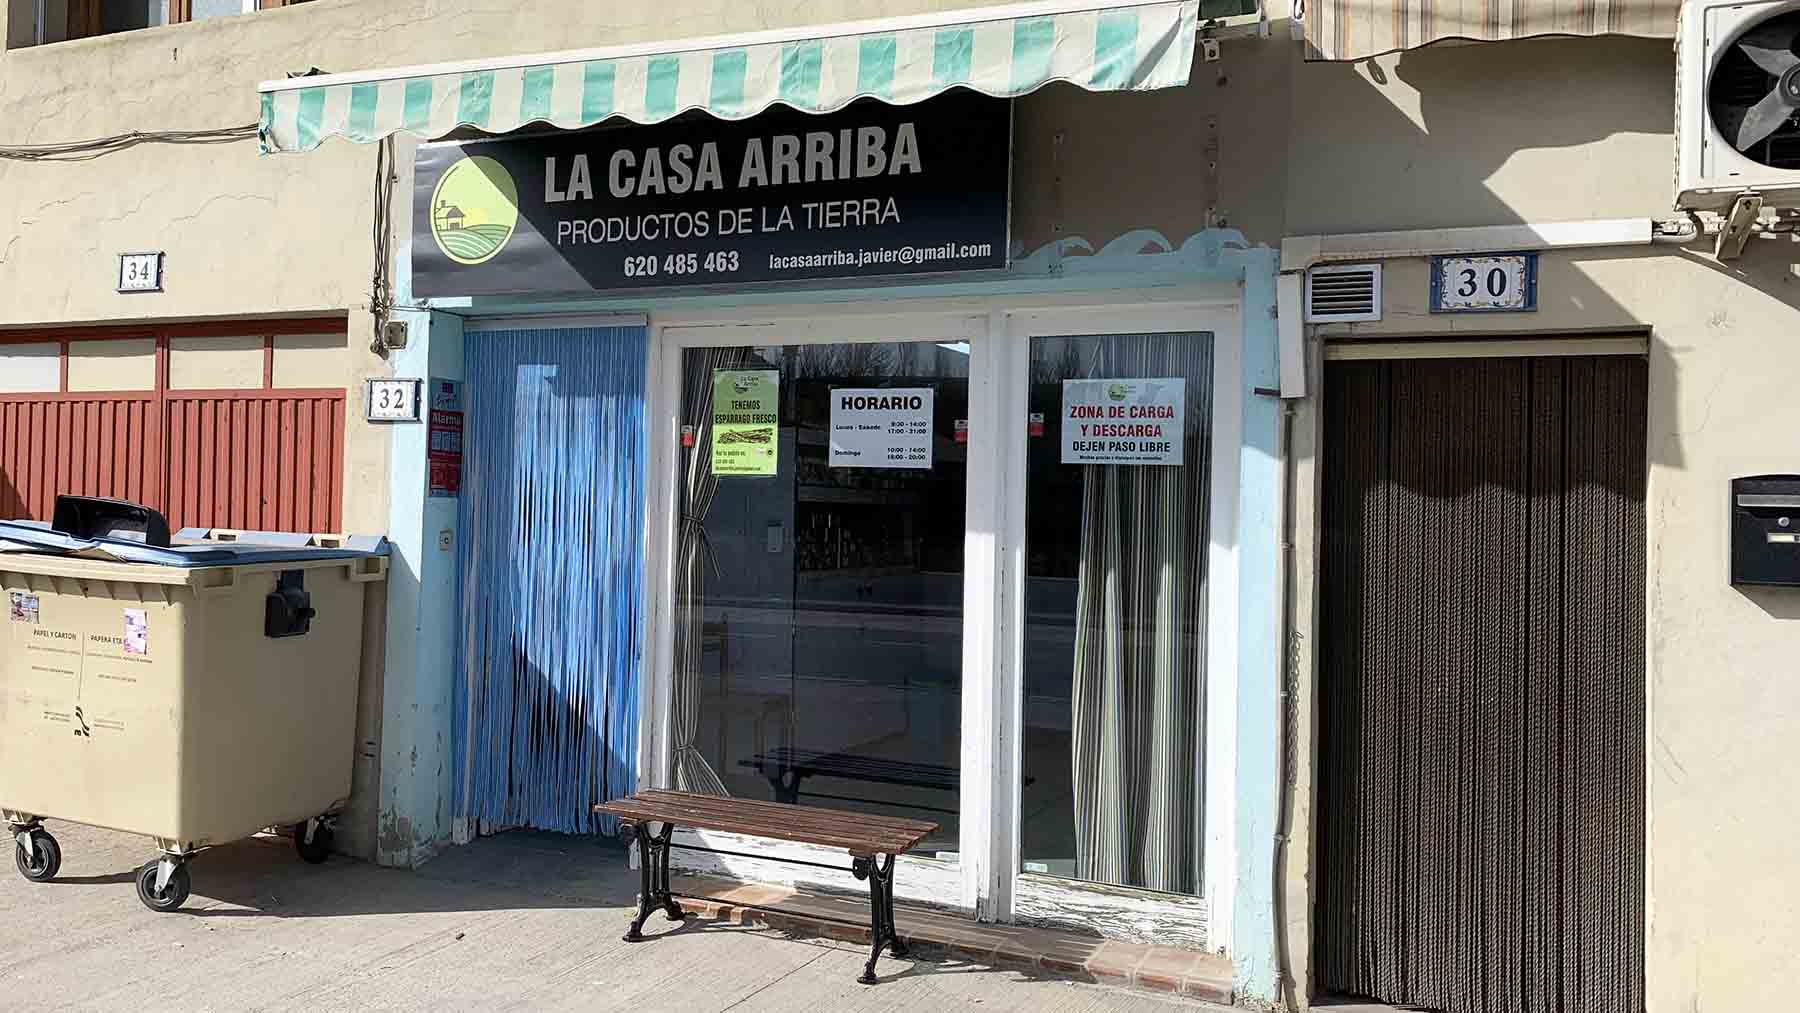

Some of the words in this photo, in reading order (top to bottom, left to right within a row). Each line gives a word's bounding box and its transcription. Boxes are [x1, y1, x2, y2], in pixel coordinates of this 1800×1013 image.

[544, 153, 593, 203] LA
[608, 143, 724, 198] CASA
[738, 122, 922, 188] ARRIBA
[557, 210, 709, 246] PRODUCTOS
[718, 207, 753, 235] DE
[761, 204, 795, 233] LA
[801, 196, 901, 230] TIERRA
[624, 256, 658, 278] 620
[663, 253, 698, 275] 485
[703, 250, 740, 274] 463
[769, 242, 992, 270] lacasaarriba.javier@gmail.com
[128, 261, 149, 281] 34
[1457, 267, 1507, 298] 30
[379, 388, 405, 409] 32
[731, 400, 760, 410] TENEMOS
[841, 396, 922, 411] HORARIO
[752, 414, 777, 424] FRESCO
[1071, 406, 1105, 419] ZONA
[1108, 406, 1125, 418] DE
[1130, 406, 1174, 419] CARGA
[1080, 424, 1089, 437] Y
[1093, 424, 1162, 437] DESCARGA
[1072, 441, 1106, 452] DEJEN
[1109, 441, 1136, 452] PASO
[1139, 442, 1171, 452] LIBRE
[33, 628, 49, 638] PAPEL
